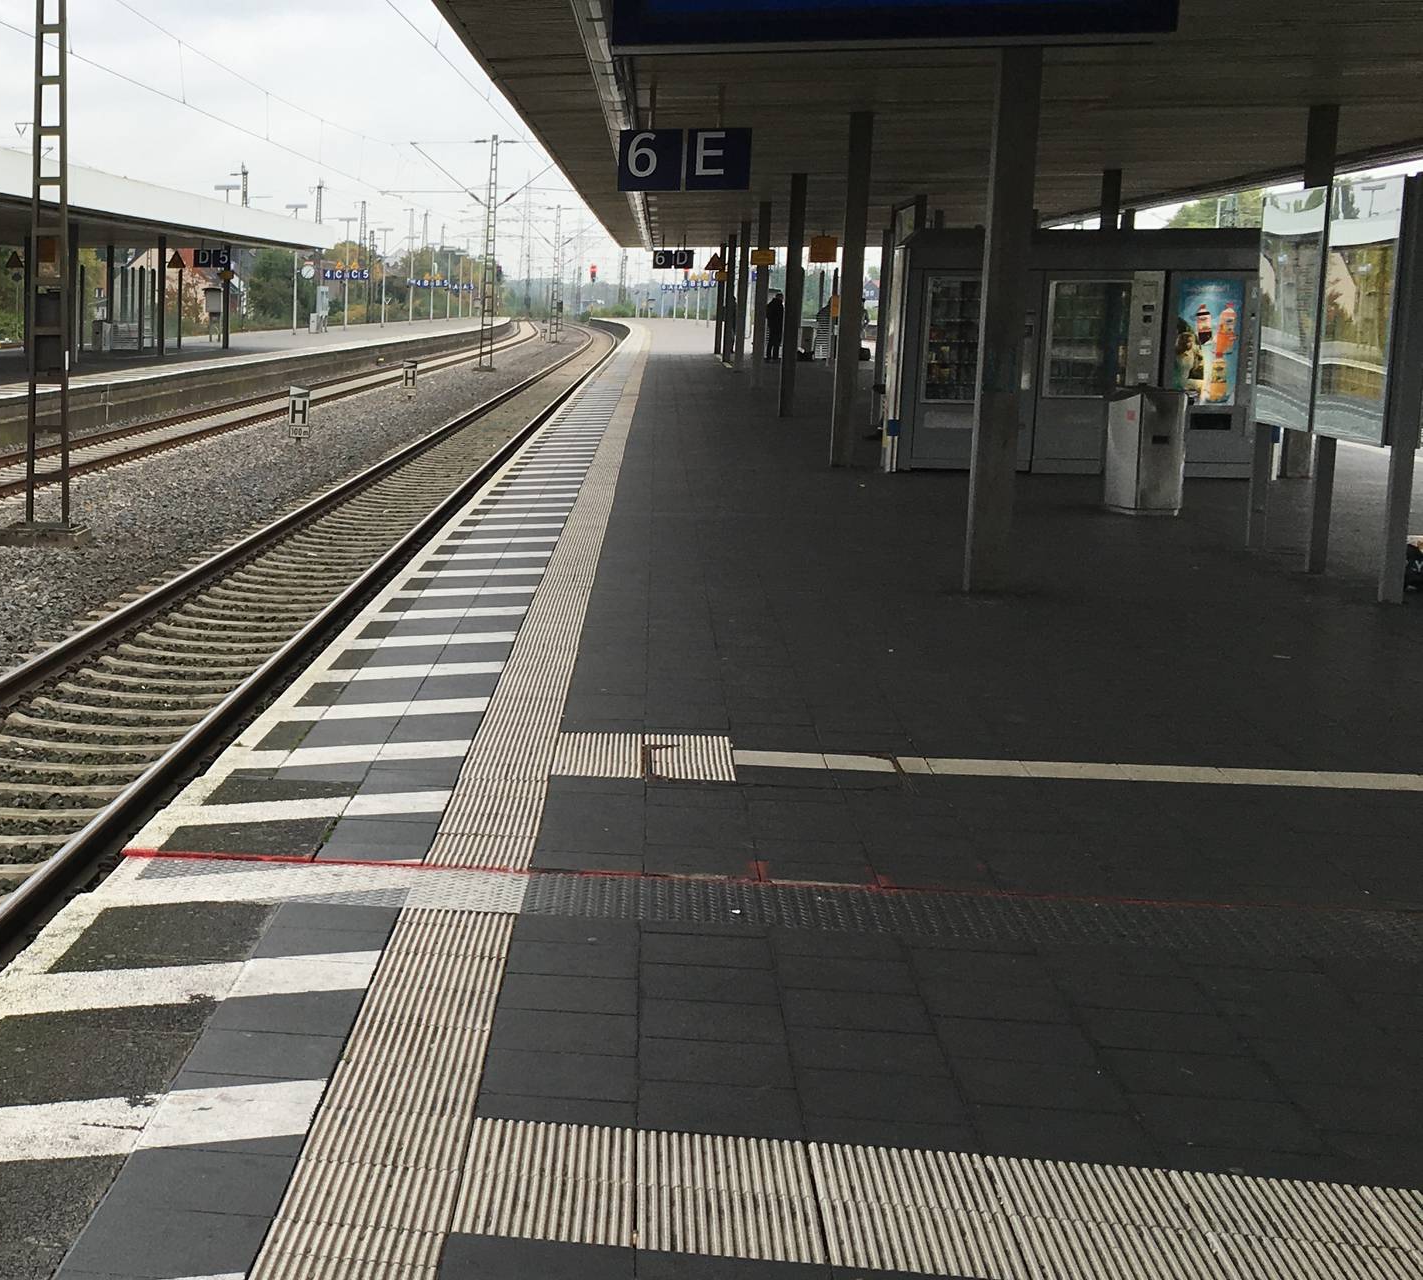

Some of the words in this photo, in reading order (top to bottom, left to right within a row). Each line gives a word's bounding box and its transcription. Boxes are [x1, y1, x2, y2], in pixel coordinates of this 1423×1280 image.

[627, 132, 657, 178] 6
[695, 131, 726, 176] E
[199, 251, 209, 264] D
[219, 250, 229, 264] 5
[655, 251, 665, 265] 6
[677, 251, 688, 265] D
[324, 270, 331, 279] 4
[335, 269, 343, 279] C
[351, 269, 359, 279] C
[362, 269, 370, 279] 5
[404, 369, 416, 387] H
[290, 399, 308, 424] H
[290, 427, 303, 436] 100
